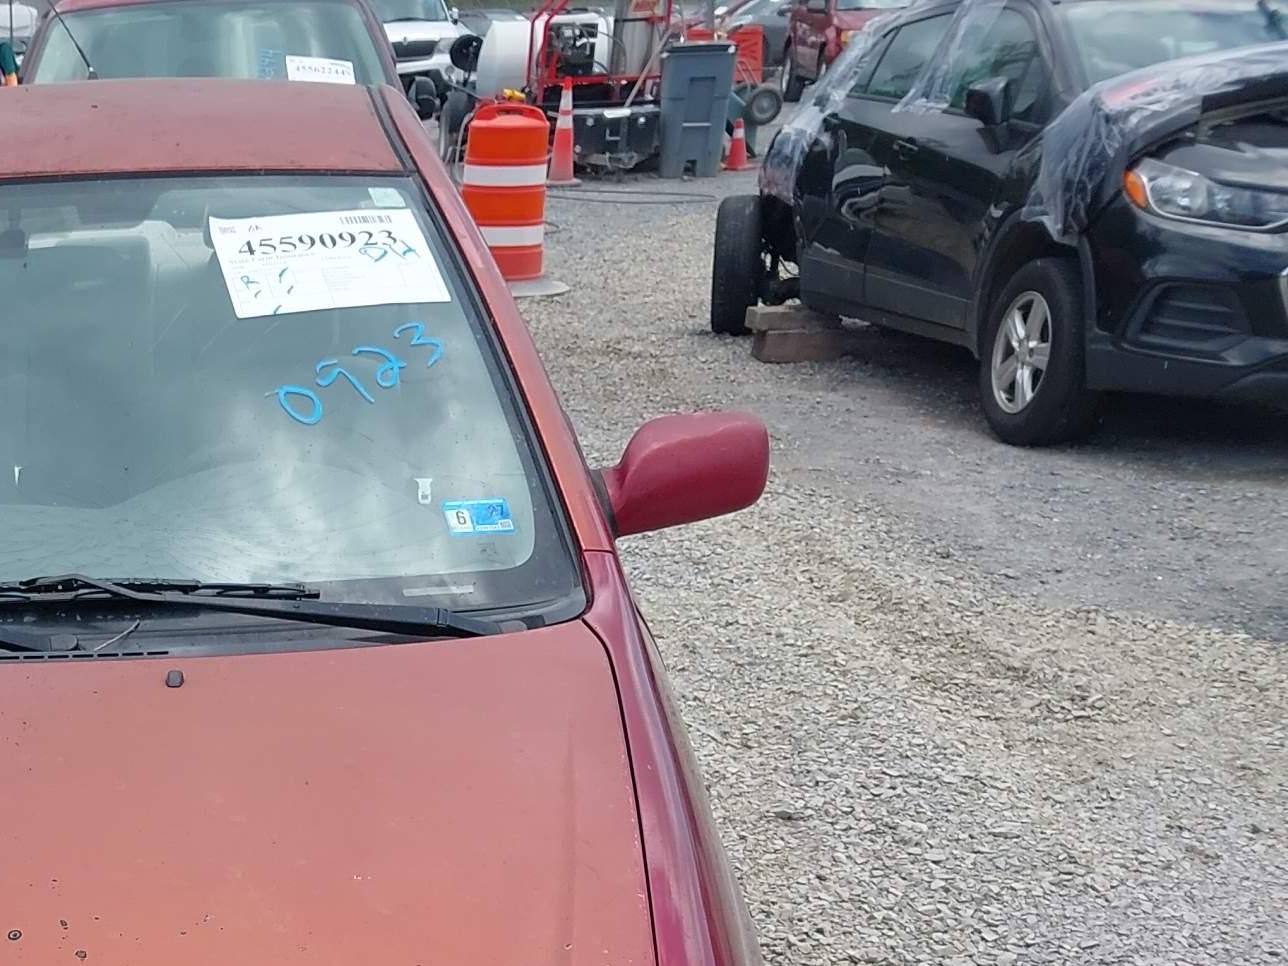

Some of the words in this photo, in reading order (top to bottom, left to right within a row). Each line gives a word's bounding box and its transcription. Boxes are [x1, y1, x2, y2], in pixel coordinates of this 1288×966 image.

[238, 229, 398, 256] 45590923
[274, 320, 445, 425] 0923
[455, 510, 467, 526] 6
